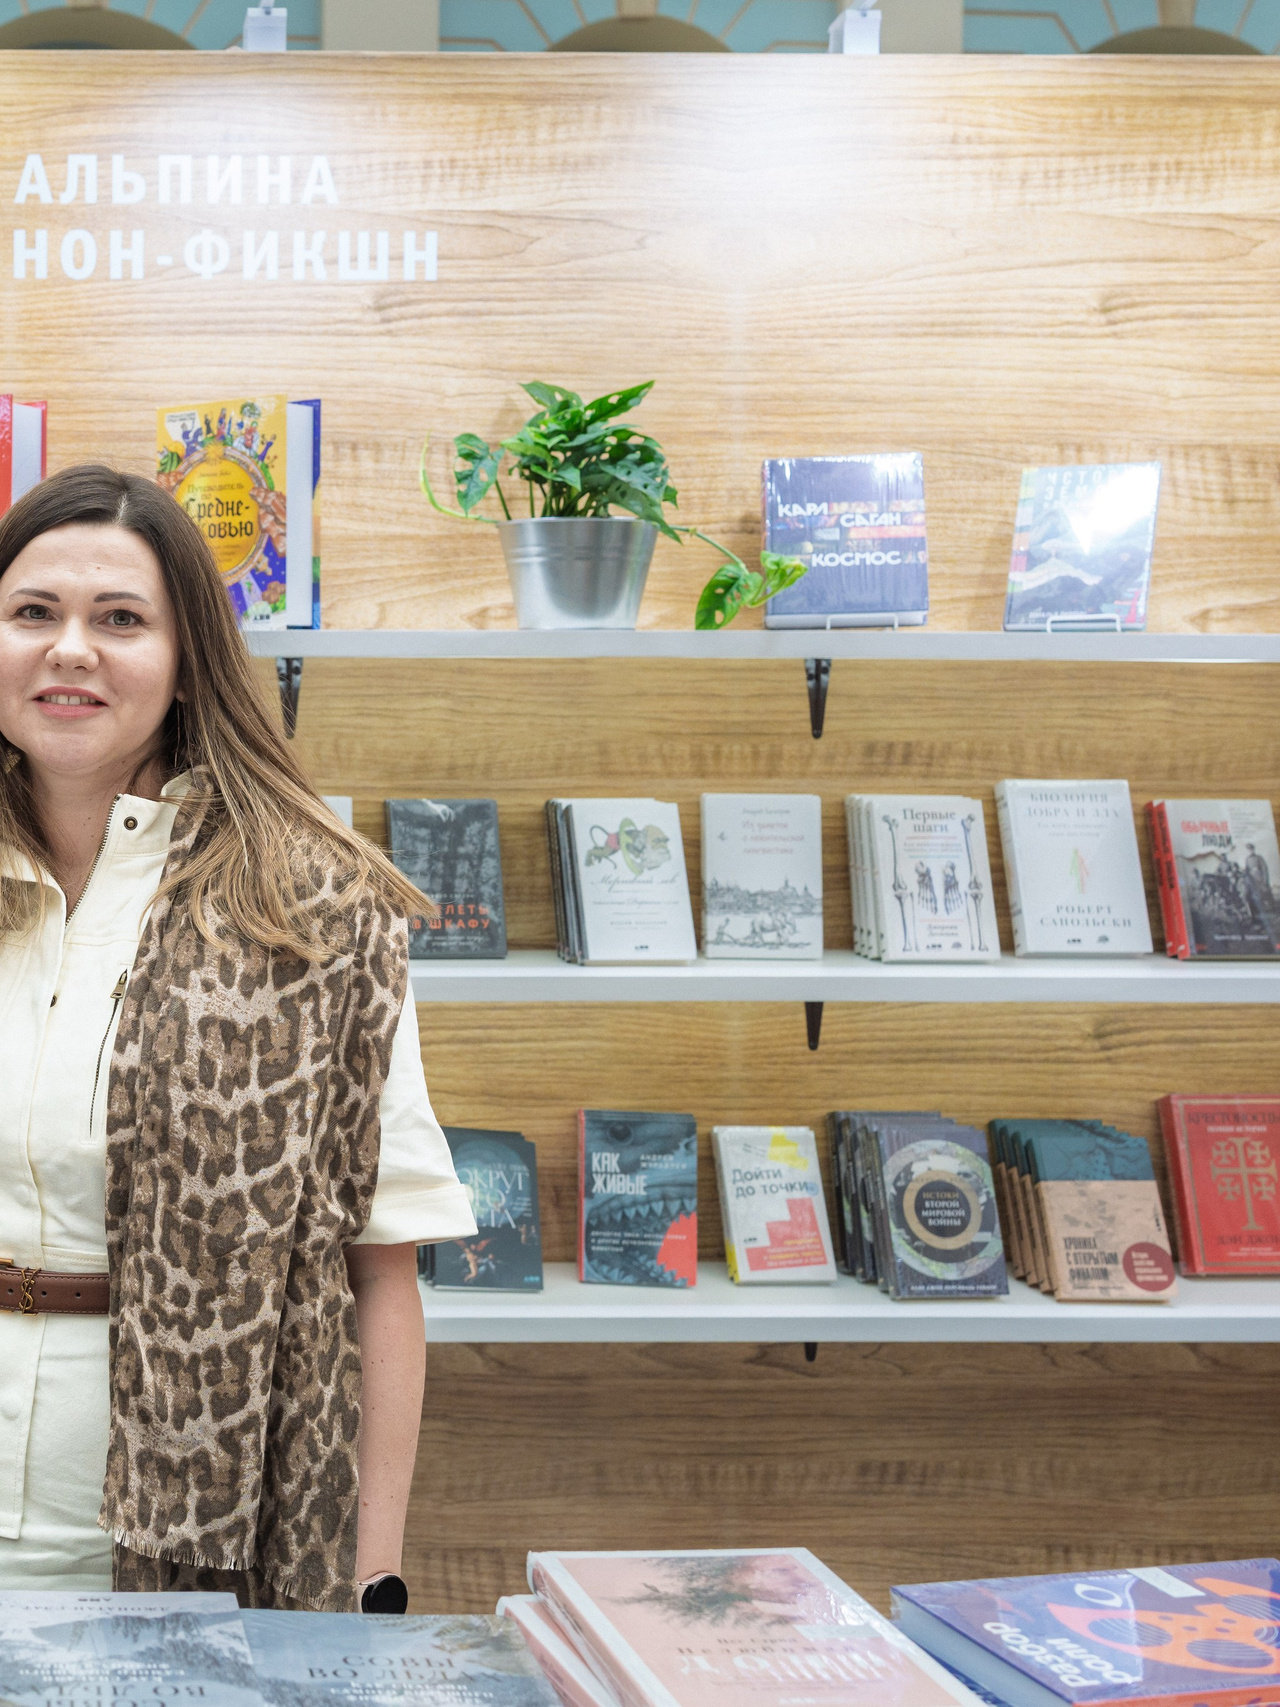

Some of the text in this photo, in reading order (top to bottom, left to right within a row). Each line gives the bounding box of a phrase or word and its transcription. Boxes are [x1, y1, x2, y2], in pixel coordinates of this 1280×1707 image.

[13, 153, 339, 204] АЛЬПИНА
[13, 228, 438, 281] НОН-ФИКШН
[778, 502, 829, 517] КАРЛ
[840, 512, 901, 527] САГАН
[811, 551, 901, 567] КОСМОС
[903, 808, 956, 823] Первые
[913, 823, 949, 833] шаги
[429, 919, 490, 929] ШКАФУ
[592, 1152, 620, 1173] КАК
[732, 1167, 782, 1184] Дойти
[592, 1173, 648, 1195] ЖИВЫЕ
[735, 1181, 809, 1198] до точки
[925, 1200, 960, 1208] ВТОРОЙ
[922, 1208, 965, 1217] МИРОВОЙ
[928, 1217, 961, 1227] ВОЙНЫ
[342, 1655, 455, 1668] СОВЫ
[983, 1621, 1101, 1688] Разбор
[1045, 1636, 1135, 1684] роли
[308, 1667, 358, 1679] ВО
